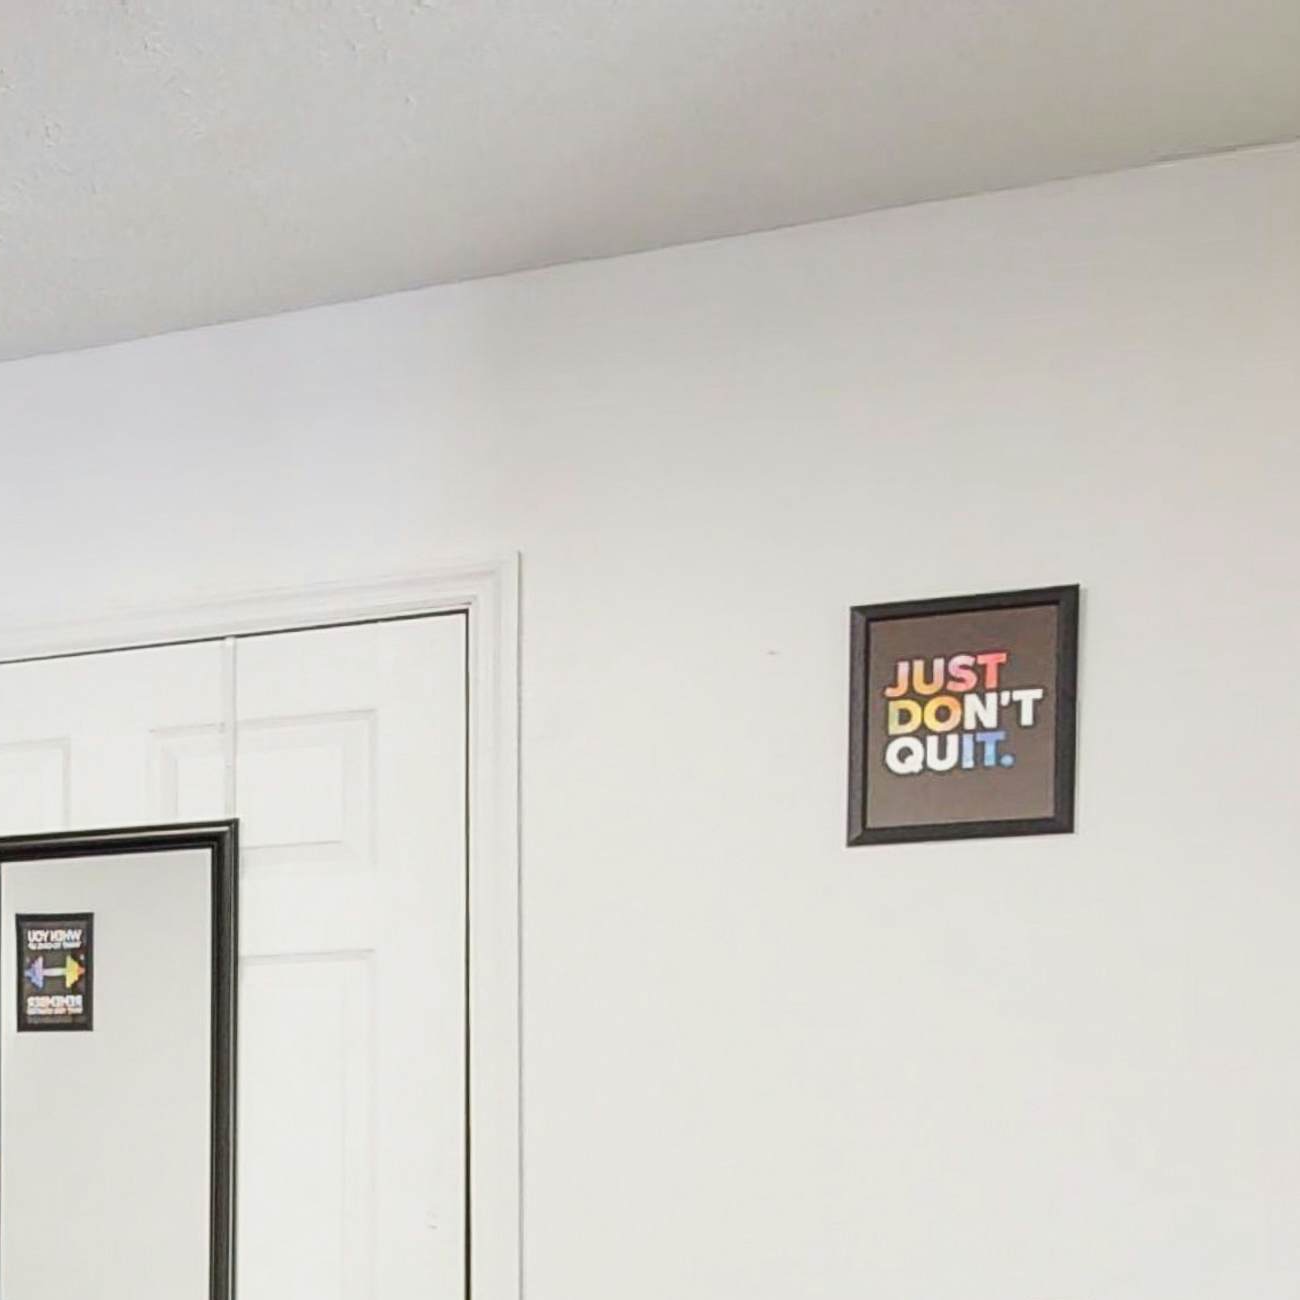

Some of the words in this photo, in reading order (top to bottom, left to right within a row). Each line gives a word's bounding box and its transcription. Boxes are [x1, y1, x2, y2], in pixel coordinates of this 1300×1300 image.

[884, 652, 1007, 697] JUST
[887, 688, 1044, 735] DON'T
[885, 731, 1015, 775] QUIT.
